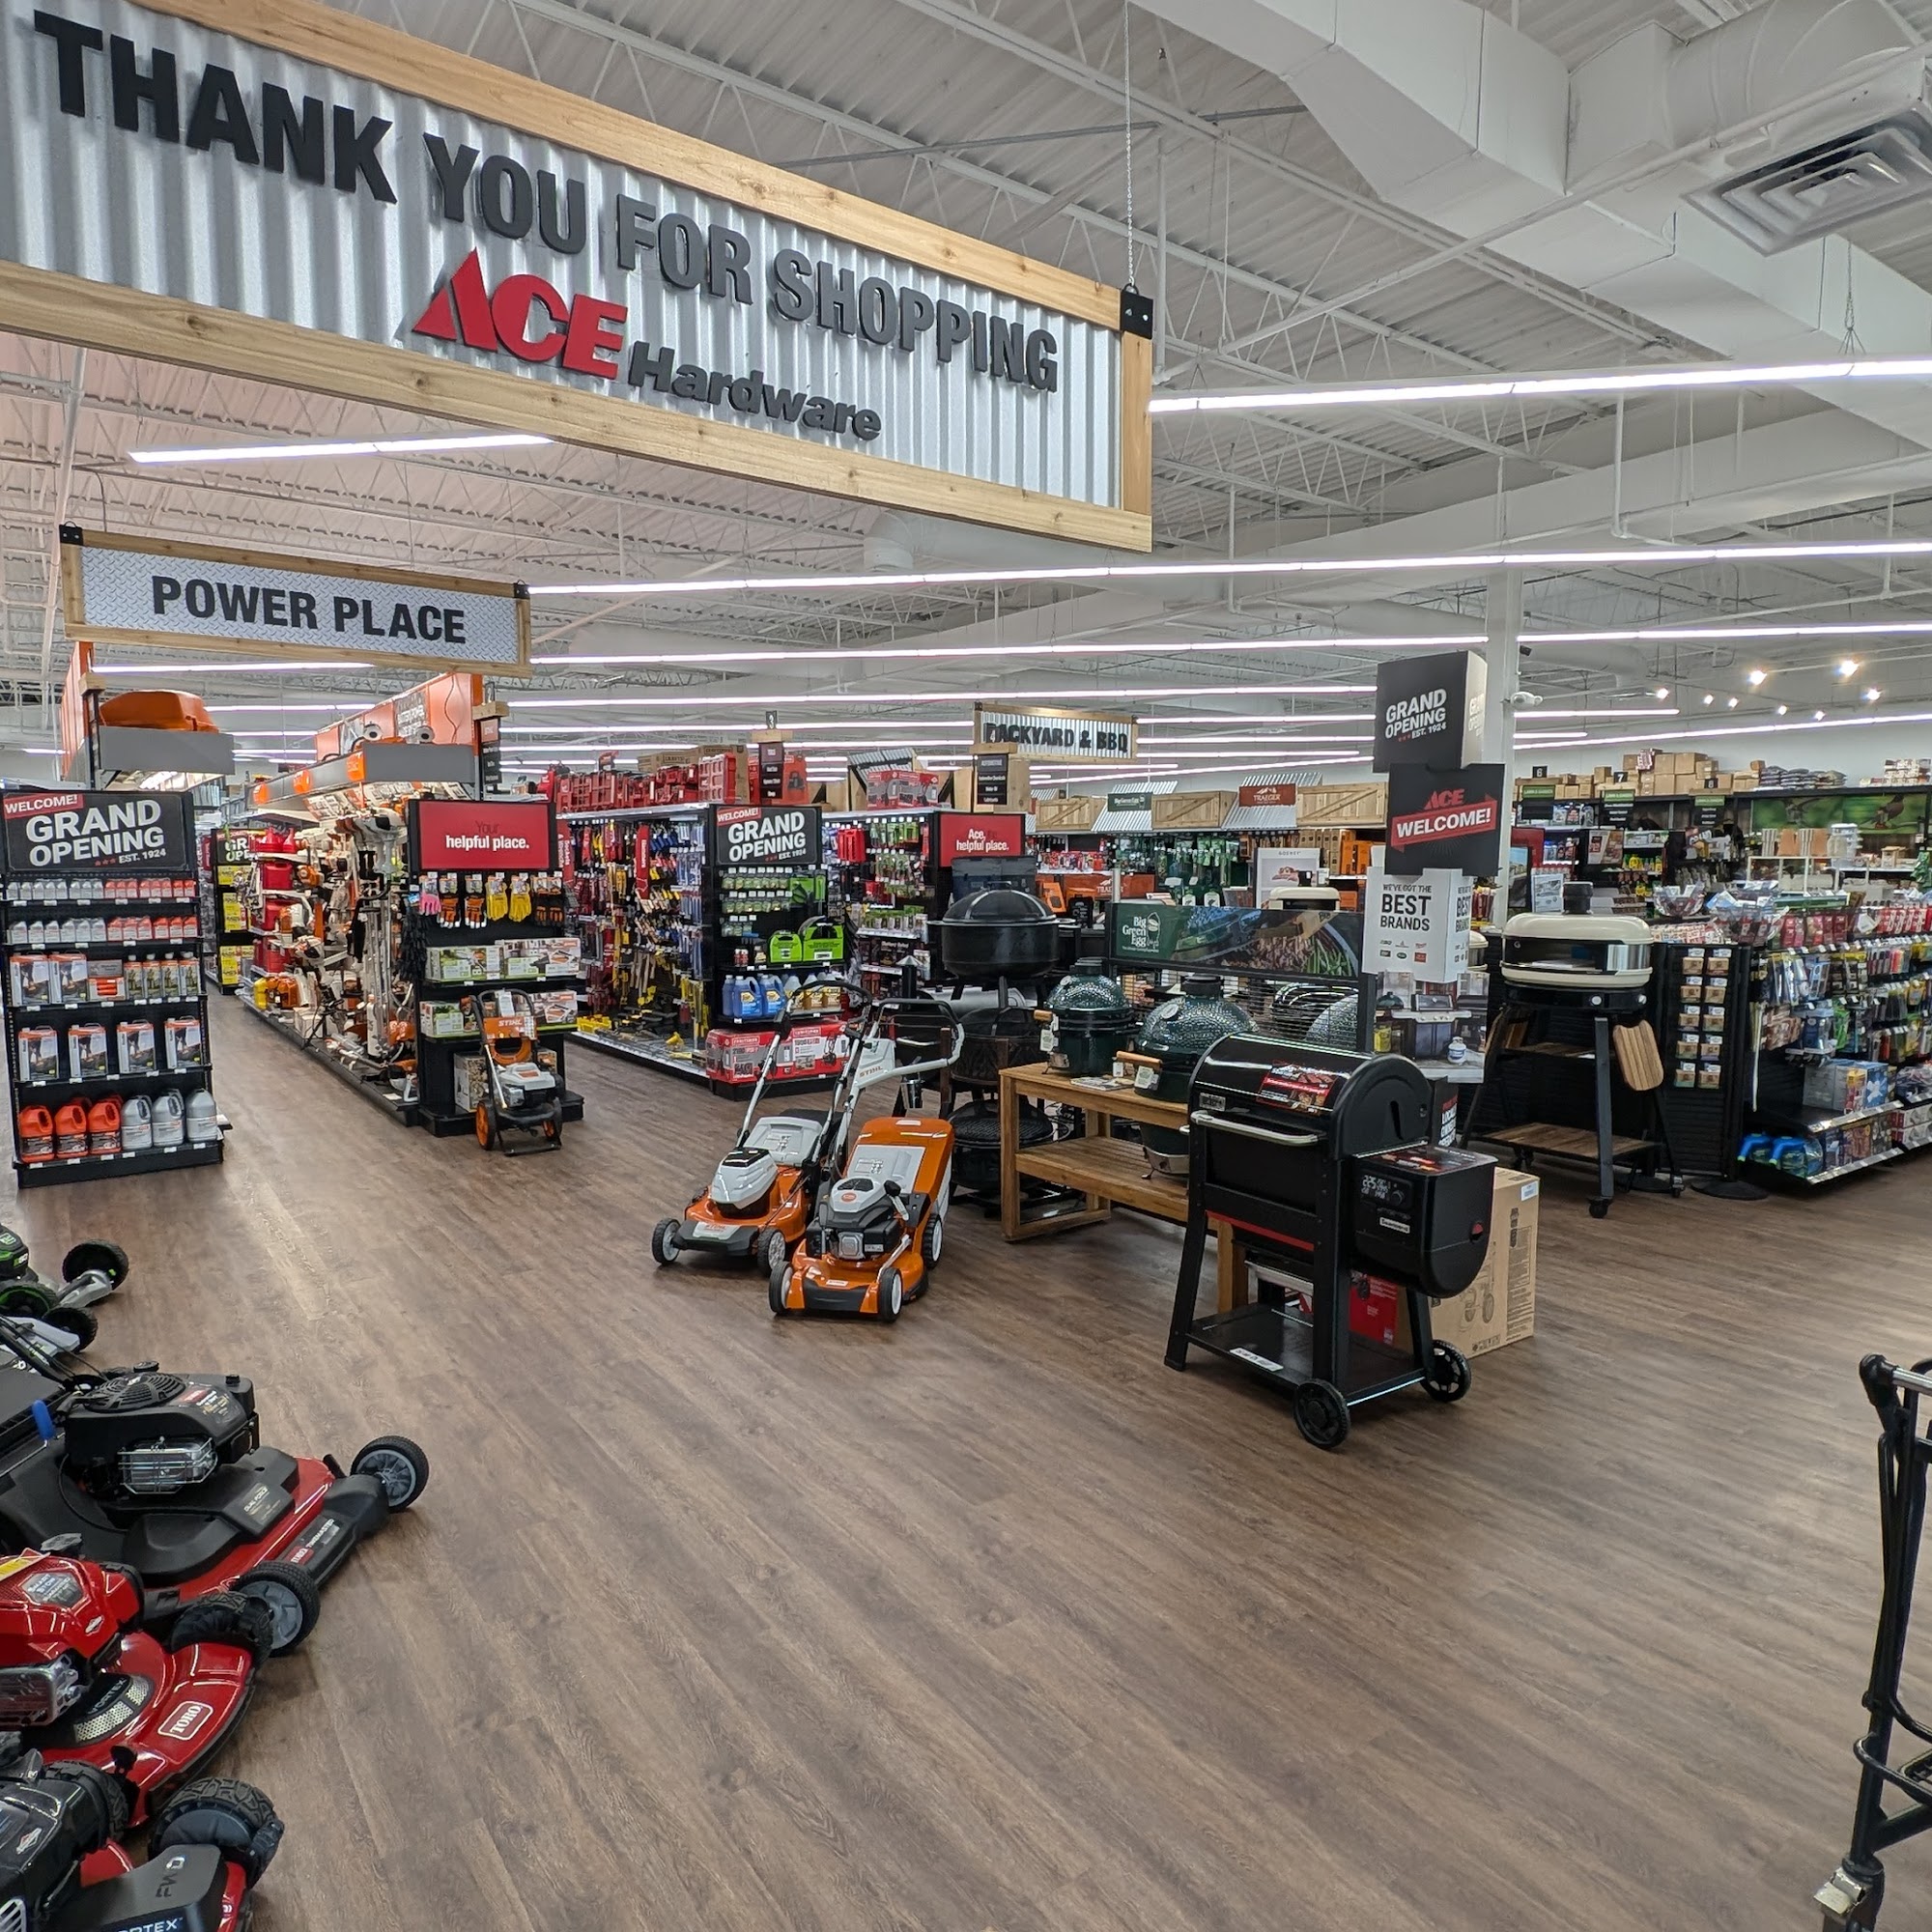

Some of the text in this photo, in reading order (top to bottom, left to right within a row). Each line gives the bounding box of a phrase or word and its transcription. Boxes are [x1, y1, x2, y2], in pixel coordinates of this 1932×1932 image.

[34, 10, 1058, 393] THANK YOU FOR SHOPPING
[412, 247, 882, 441] ACE Hardware
[152, 575, 467, 644] POWER PLACE
[1385, 688, 1447, 724] GRAND
[1384, 707, 1446, 739] OPENING
[1411, 721, 1447, 739] EST. 1924
[1079, 729, 1092, 749] &
[1096, 731, 1128, 753] BBQ
[1617, 774, 1624, 782] 7
[4, 793, 78, 814] WELCOME!
[1253, 793, 1281, 802] TRAEGER
[1423, 788, 1465, 810] ACE
[25, 799, 161, 843] GRAND
[717, 808, 759, 822] WELCOME!
[1396, 808, 1492, 838] WELCOME!
[474, 820, 500, 835] Your
[727, 811, 805, 843] GRAND
[968, 828, 986, 841] Ace,
[29, 826, 164, 867] OPENING
[445, 835, 530, 851] helpful place.
[728, 832, 806, 862] OPENING
[955, 839, 1009, 853] helpful place.
[118, 848, 166, 864] EST. 1924
[1382, 883, 1433, 894] WE'VE GOT THE
[1381, 893, 1432, 916] BEST
[1122, 924, 1147, 936] Green
[1133, 916, 1147, 928] Big
[1379, 915, 1431, 932] BRANDS
[1130, 934, 1147, 948] Egg
[859, 1065, 884, 1078] STIHL
[290, 1548, 309, 1564] TORO
[170, 1705, 202, 1733] TORO
